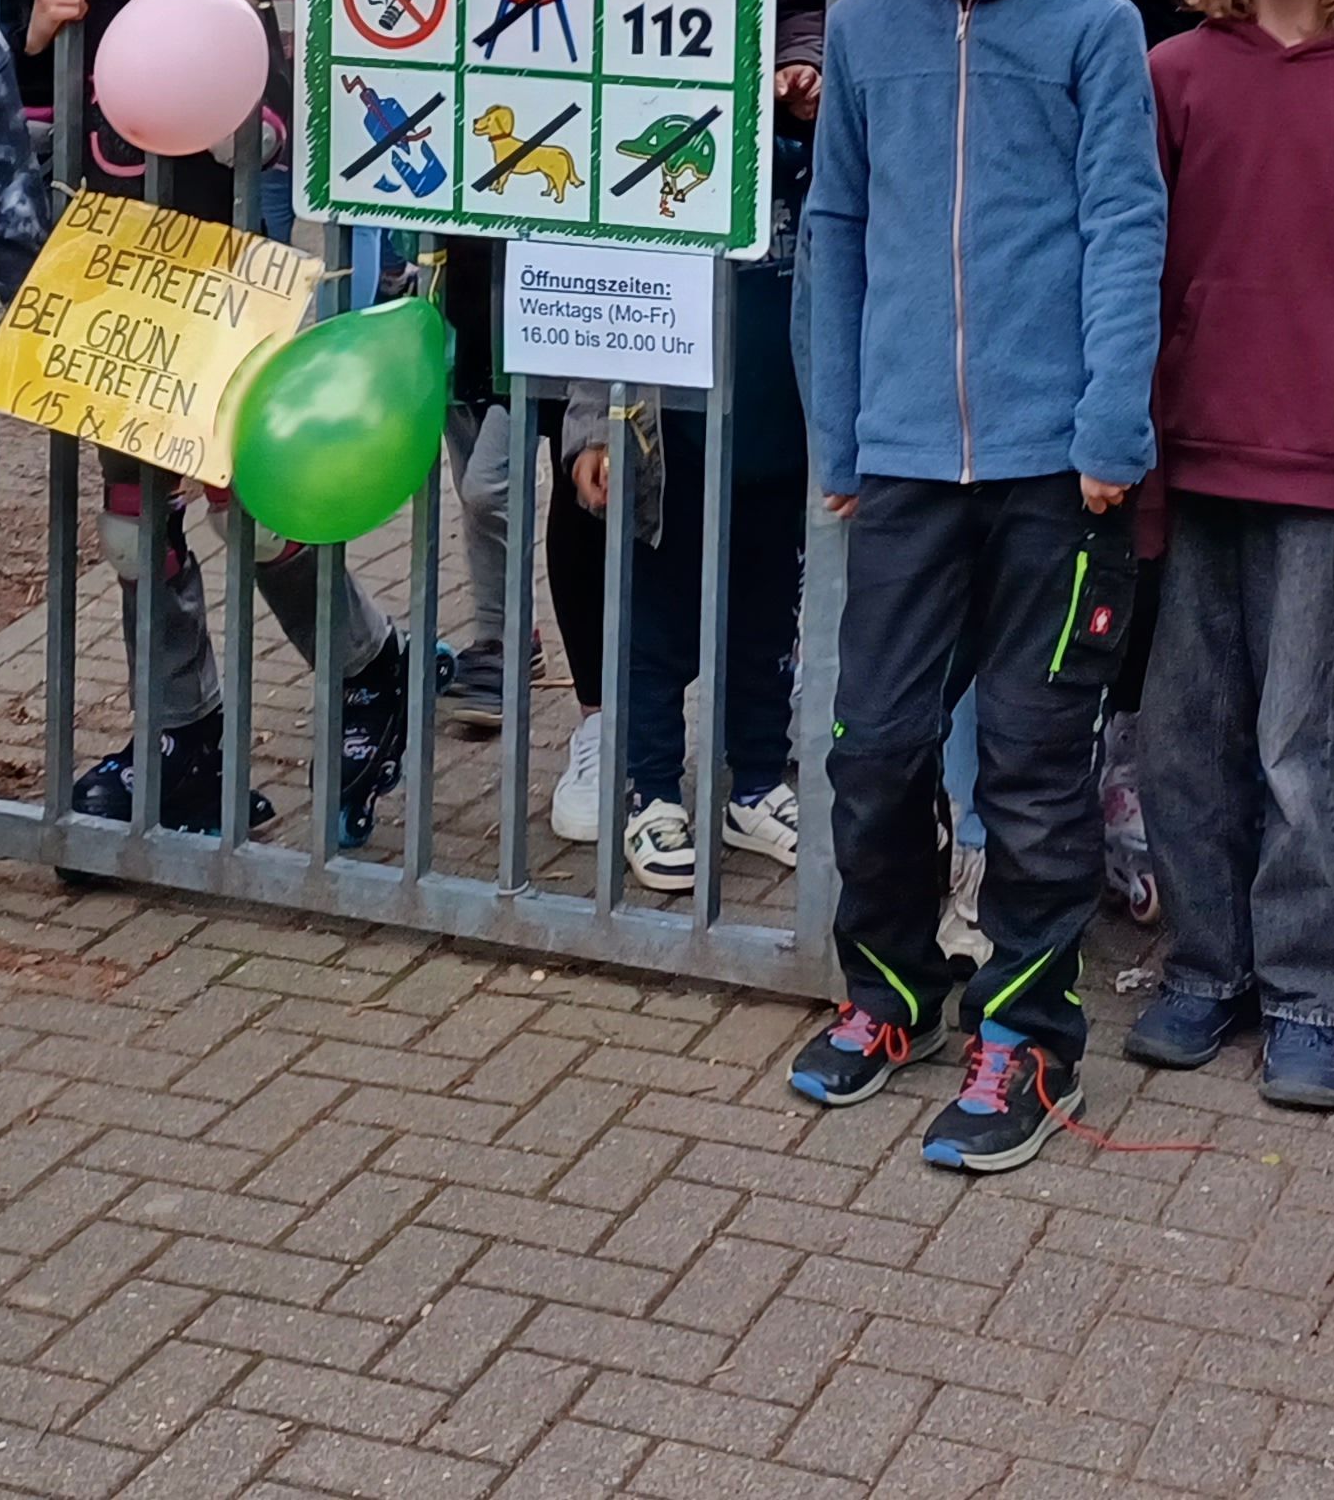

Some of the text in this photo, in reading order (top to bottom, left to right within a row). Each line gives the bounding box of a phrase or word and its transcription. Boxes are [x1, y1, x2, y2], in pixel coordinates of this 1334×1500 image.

[622, 1, 714, 58] 112
[66, 192, 128, 237] BEI
[83, 243, 249, 328] BETRETEN
[520, 264, 672, 297] Öffnungszeiten:
[9, 286, 181, 371] BEI GRÜN
[519, 297, 677, 329] Werktags (Mo-Fr)
[521, 325, 695, 355] 16.00 bis 20.00 Uhr
[43, 344, 198, 416] BETRETEN
[77, 405, 106, 440] &
[118, 417, 150, 453] 16
[154, 431, 206, 478] UHR)
